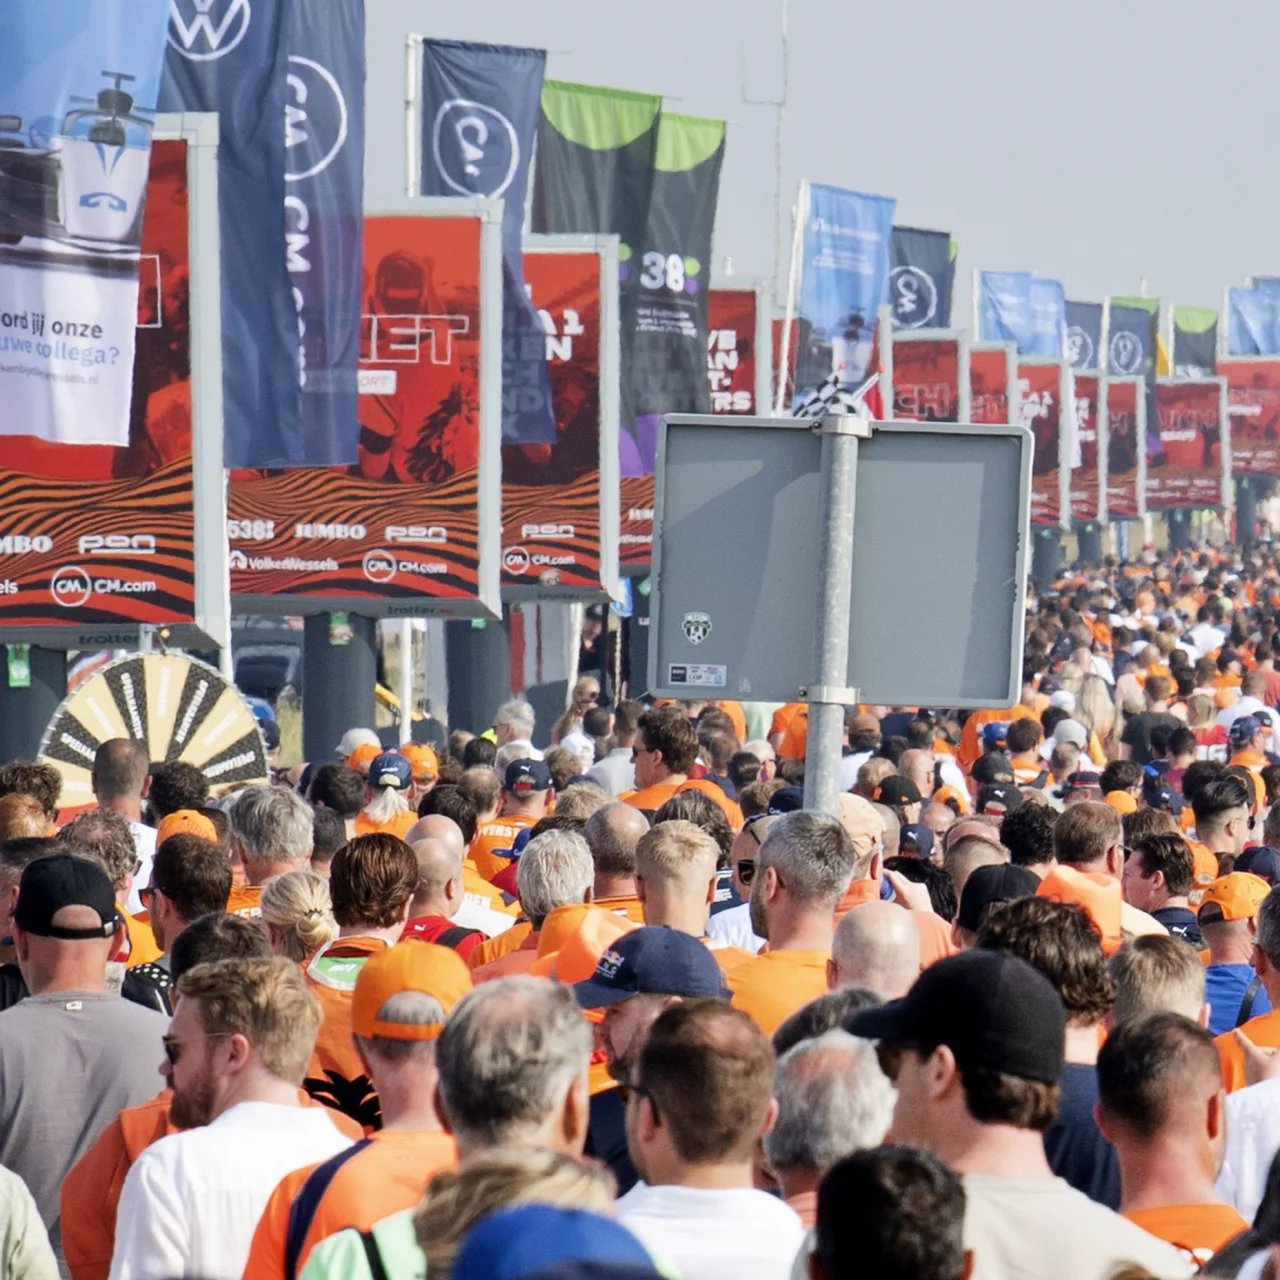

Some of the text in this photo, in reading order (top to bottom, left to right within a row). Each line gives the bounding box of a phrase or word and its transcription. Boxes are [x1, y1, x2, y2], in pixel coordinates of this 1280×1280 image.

[0, 310, 28, 329] ord
[51, 320, 103, 339] onze
[292, 523, 366, 540] JUMBO
[399, 562, 448, 575] CM.com
[94, 578, 157, 594] CM.com
